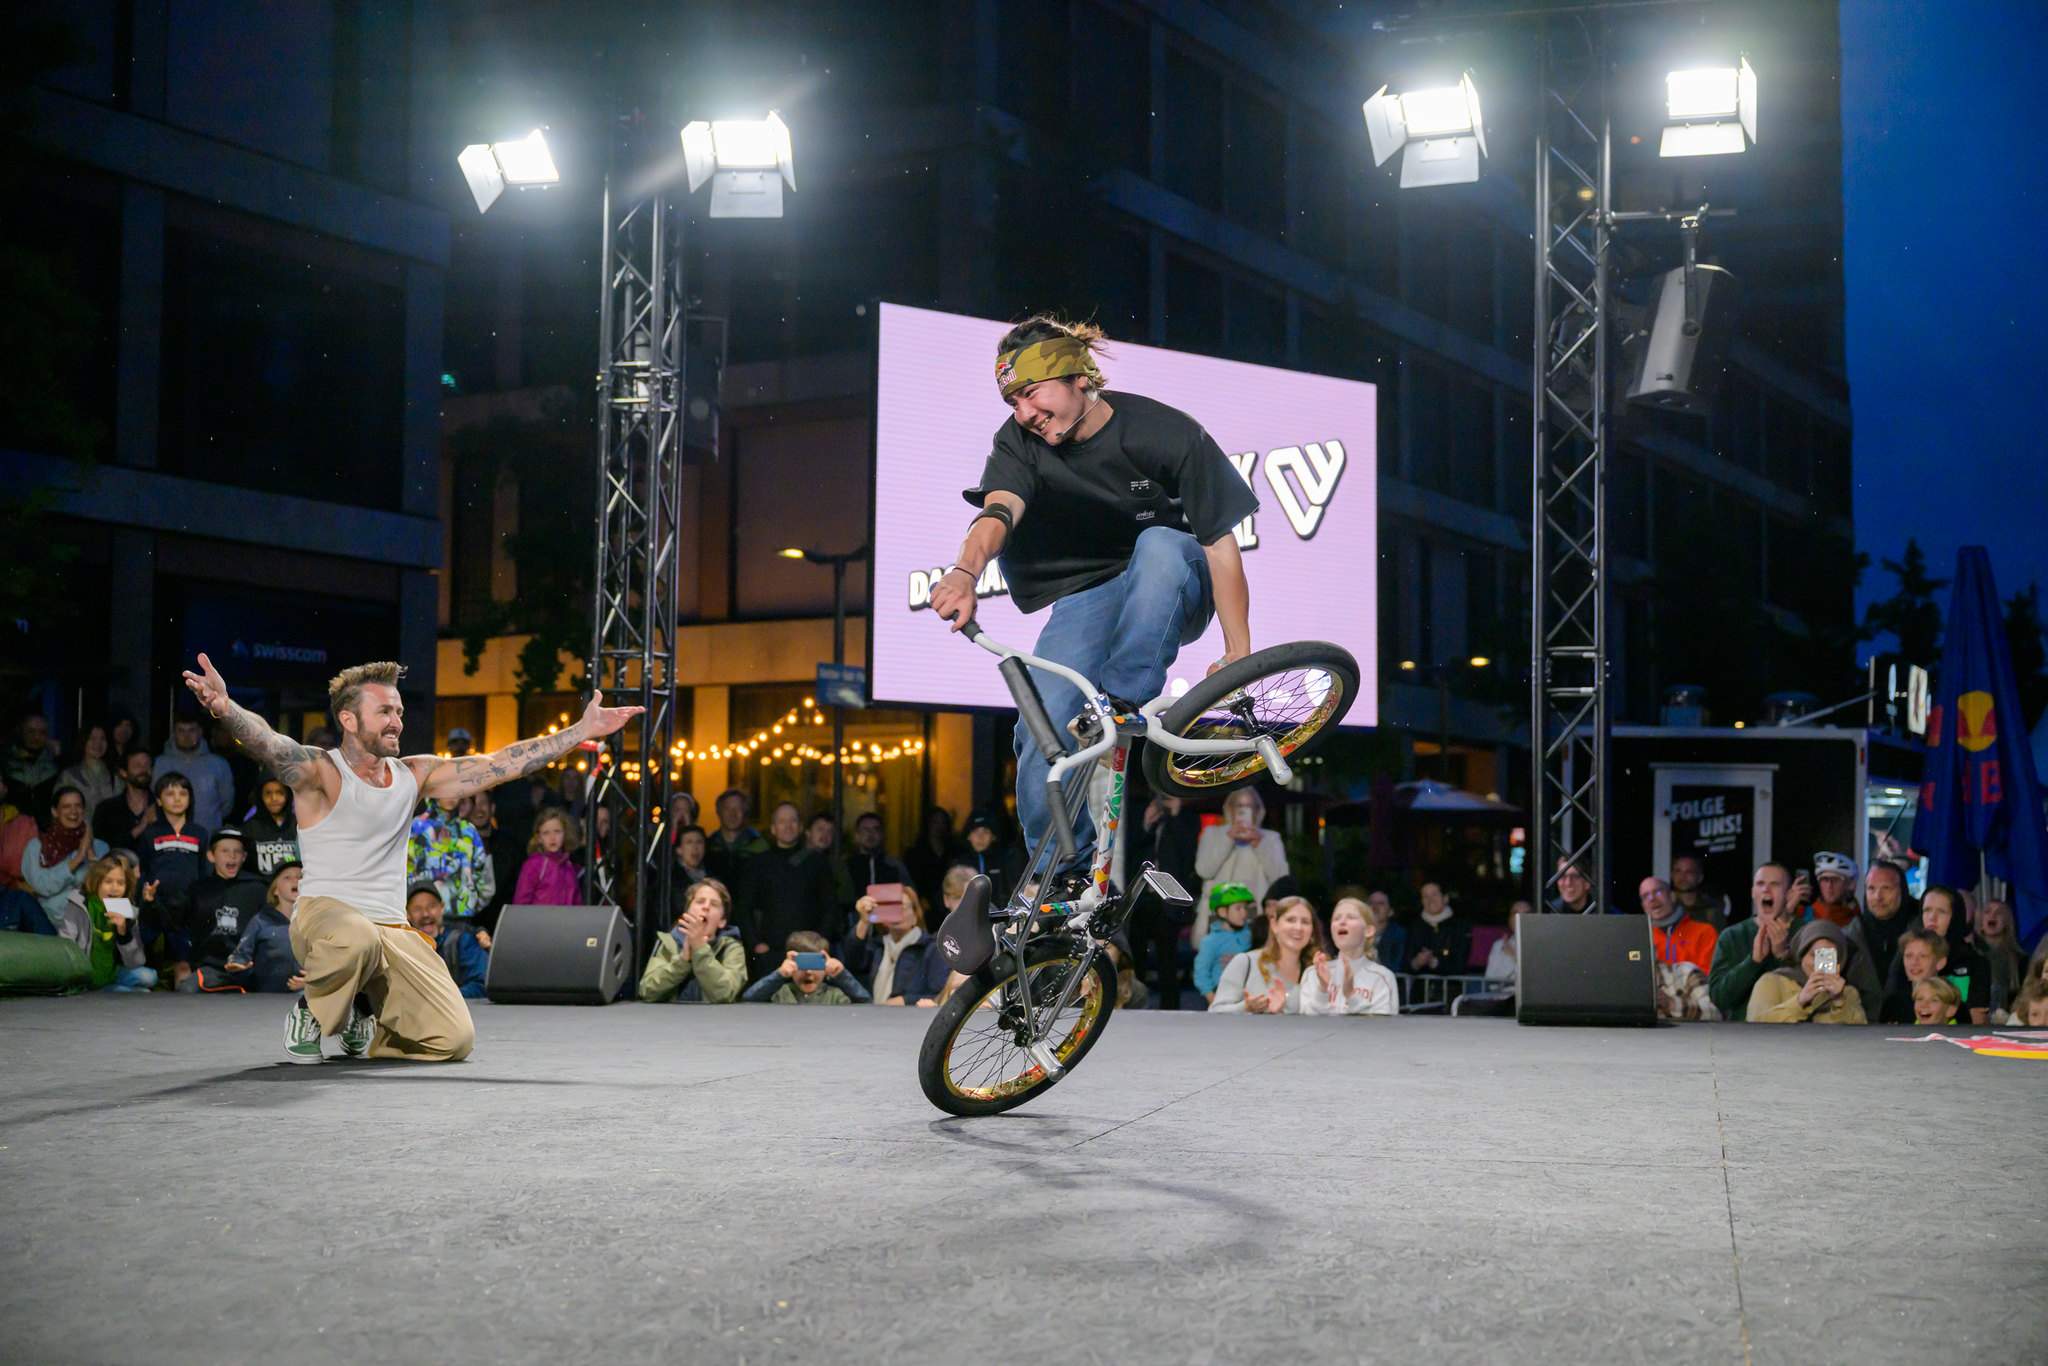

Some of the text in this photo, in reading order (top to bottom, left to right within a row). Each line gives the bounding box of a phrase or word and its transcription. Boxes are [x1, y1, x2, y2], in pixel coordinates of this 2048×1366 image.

[253, 643, 327, 663] swisscom
[1671, 796, 1725, 821] FOLGE
[1699, 813, 1742, 837] UNS!
